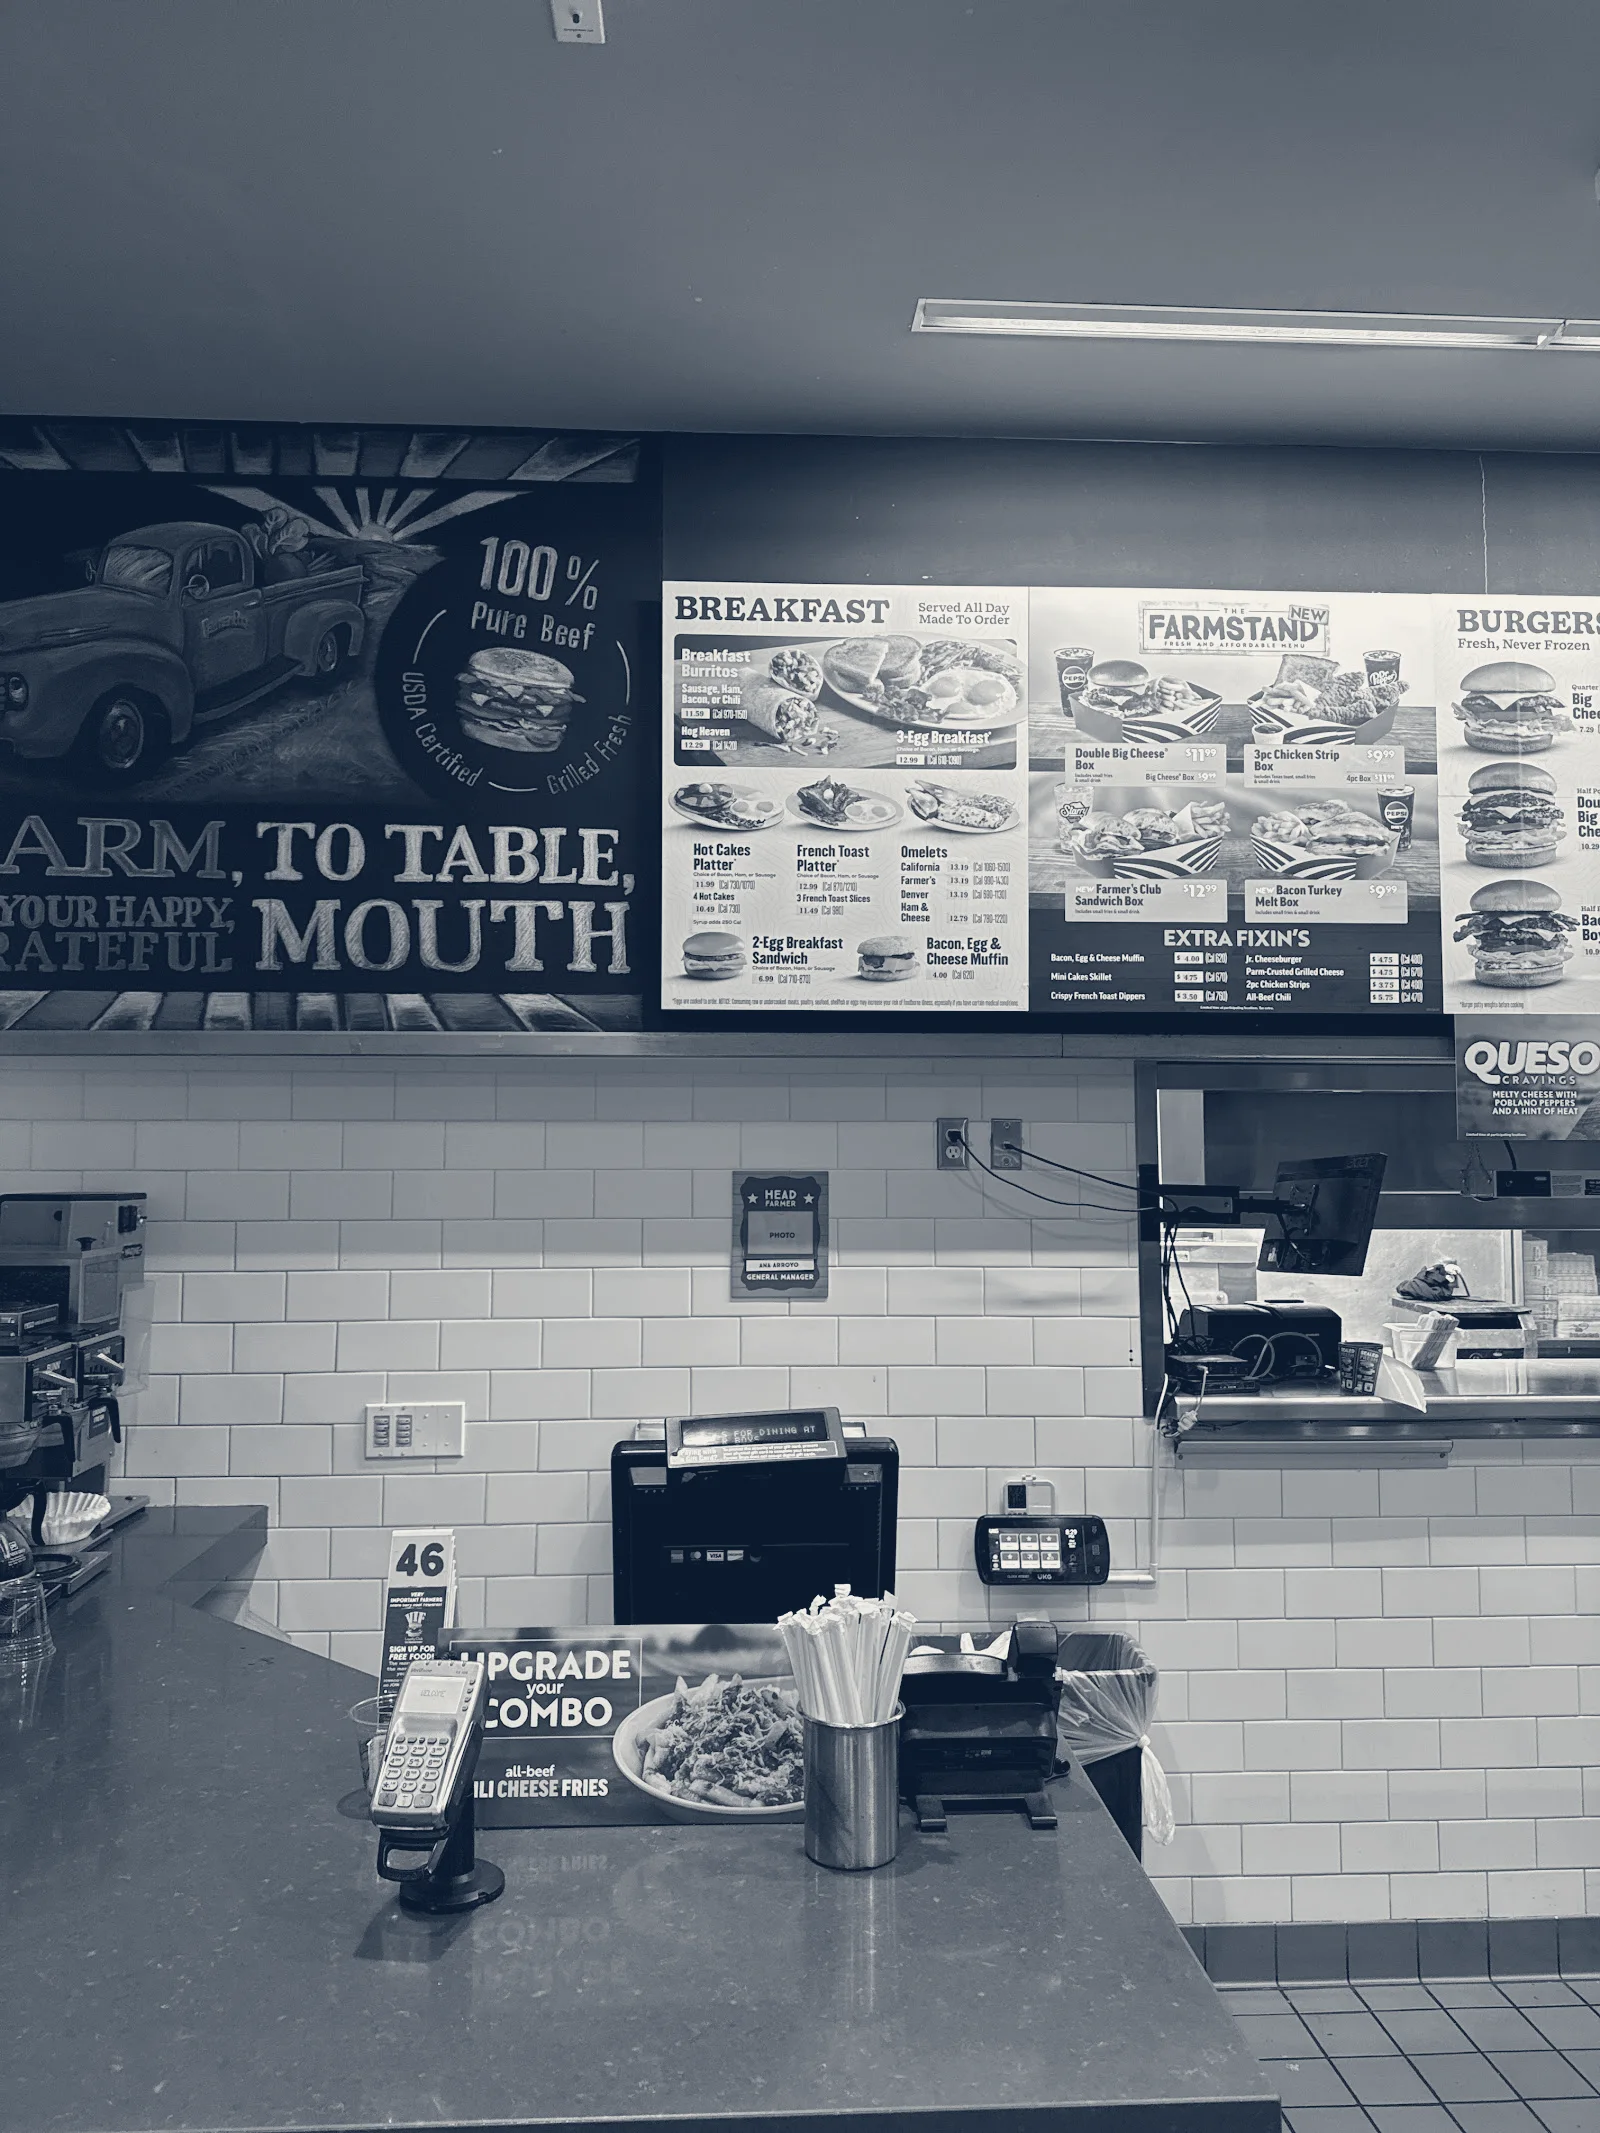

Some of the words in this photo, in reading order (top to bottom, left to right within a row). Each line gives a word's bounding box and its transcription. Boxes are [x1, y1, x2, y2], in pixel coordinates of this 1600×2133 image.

[675, 596, 889, 624] BREAKFAST
[918, 603, 960, 613] Served
[964, 604, 982, 613] All
[986, 604, 1010, 616] Day
[1290, 606, 1327, 622] NEW
[471, 601, 528, 639] Pure
[541, 615, 596, 651] Beef
[919, 615, 953, 625] Made
[956, 615, 970, 624] To
[974, 615, 1010, 625] Order
[1457, 609, 1600, 635] BURGER
[1149, 614, 1319, 642] FARMSTAND
[1458, 638, 1500, 651] Fresh,
[1503, 639, 1542, 650] Never
[1544, 639, 1591, 651] Frozen
[681, 648, 751, 662] Breakfast
[682, 664, 738, 678] Burritos
[682, 684, 720, 695] Sausage,
[721, 684, 743, 694] Ham,
[682, 694, 710, 705] Bacon,
[711, 696, 721, 704] or
[722, 694, 741, 705] Chili
[402, 672, 427, 720] USDA
[416, 723, 484, 787] Certified
[682, 726, 698, 738] Hog
[700, 727, 730, 736] Heaven
[547, 753, 600, 794] Grilled
[594, 715, 632, 761] Fresh
[1075, 748, 1110, 759] Double
[1112, 748, 1129, 761] Big
[1254, 749, 1272, 762] 3pc
[1274, 749, 1314, 760] Chicken
[1315, 750, 1340, 762] Strip
[1075, 760, 1095, 770] Box
[1254, 761, 1274, 772] Box
[1346, 775, 1359, 785] 4pc
[1360, 775, 1371, 783] Box
[693, 843, 714, 856] Hot
[716, 844, 751, 856] Cakes
[797, 845, 836, 857] French
[838, 845, 870, 858] Toast
[901, 846, 947, 858] Omelets
[256, 822, 366, 881] TO
[385, 825, 635, 896] TABLE,
[901, 862, 940, 872] California
[950, 863, 969, 871] 13.19
[901, 876, 936, 885] Farmer's
[799, 883, 818, 891] 12.99
[1096, 884, 1138, 895] Farmer's
[1140, 884, 1162, 895] Club
[1276, 885, 1306, 896] Bacon
[1308, 885, 1342, 898] Turkey
[796, 894, 802, 902] 3
[803, 894, 827, 902] French
[828, 895, 848, 903] Toast
[849, 895, 871, 903] Slices
[901, 890, 929, 899] Denver
[901, 902, 919, 911] Ham
[920, 903, 929, 911] &
[1075, 896, 1123, 907] Sandwich
[1125, 896, 1144, 906] Box
[1255, 897, 1278, 908] Melt
[1280, 897, 1299, 908] Box
[0, 895, 100, 928] YOUR
[105, 896, 235, 933] HAPPY,
[901, 913, 930, 922] Cheese
[252, 899, 631, 974] MOUTH
[1164, 929, 1233, 947] EXTRA
[1237, 929, 1311, 948] FIXIN'S
[752, 936, 784, 952] 2-Egg
[786, 936, 844, 950] Breakfast
[927, 937, 965, 950] Bacon,
[967, 937, 989, 953] Egg
[990, 937, 1002, 950] &
[752, 952, 808, 965] Sandwich
[927, 953, 968, 965] Cheese
[970, 953, 1009, 965] Muffin
[1245, 954, 1254, 964] Jr.
[1254, 954, 1302, 965] Cheeseburger
[1050, 973, 1066, 982] Mini
[1067, 973, 1088, 982] Cakes
[1089, 973, 1112, 983] Skillet
[1245, 967, 1294, 977] Parm-Crusted
[1294, 967, 1318, 977] Grilled
[1319, 967, 1344, 977] Cheese
[1246, 980, 1260, 991] 2pc
[1260, 980, 1288, 989] Chicken
[1289, 980, 1310, 991] Strips
[1050, 992, 1073, 1003] Crispy
[1074, 992, 1098, 1001] French
[1098, 992, 1118, 1001] Toast
[1118, 992, 1147, 1003] Dippers
[1246, 992, 1275, 1002] All-Beef
[1275, 992, 1292, 1002] Chili
[1464, 1041, 1600, 1085] QUESO
[1502, 1075, 1576, 1085] CRAVINGS
[1492, 1091, 1520, 1099] MELTY
[1521, 1091, 1554, 1099] CHEESE
[1555, 1091, 1578, 1099] WITH
[1495, 1099, 1538, 1107] POBLANO
[1539, 1099, 1576, 1107] PEPPERS
[1492, 1107, 1511, 1115] AND
[1513, 1107, 1520, 1115] A
[1521, 1107, 1542, 1115] HINT
[1543, 1107, 1555, 1115] OF
[1557, 1107, 1578, 1115] HEAT
[765, 1189, 797, 1200] HEAD
[765, 1200, 797, 1208] FARMER
[746, 1273, 779, 1281] GENERAL
[781, 1273, 815, 1281] MANAGER
[759, 1427, 798, 1437] DINING
[804, 1425, 816, 1434] AT
[396, 1542, 445, 1577] 46
[389, 1645, 407, 1653] SIGN
[407, 1645, 419, 1653] UP
[419, 1645, 436, 1653] FOR
[388, 1653, 408, 1661] FREE
[409, 1652, 435, 1661] FOOD!
[526, 1682, 564, 1699] your
[505, 1764, 555, 1778] all-beef
[497, 1779, 559, 1798] CHEESE
[561, 1779, 609, 1797] FRIES
